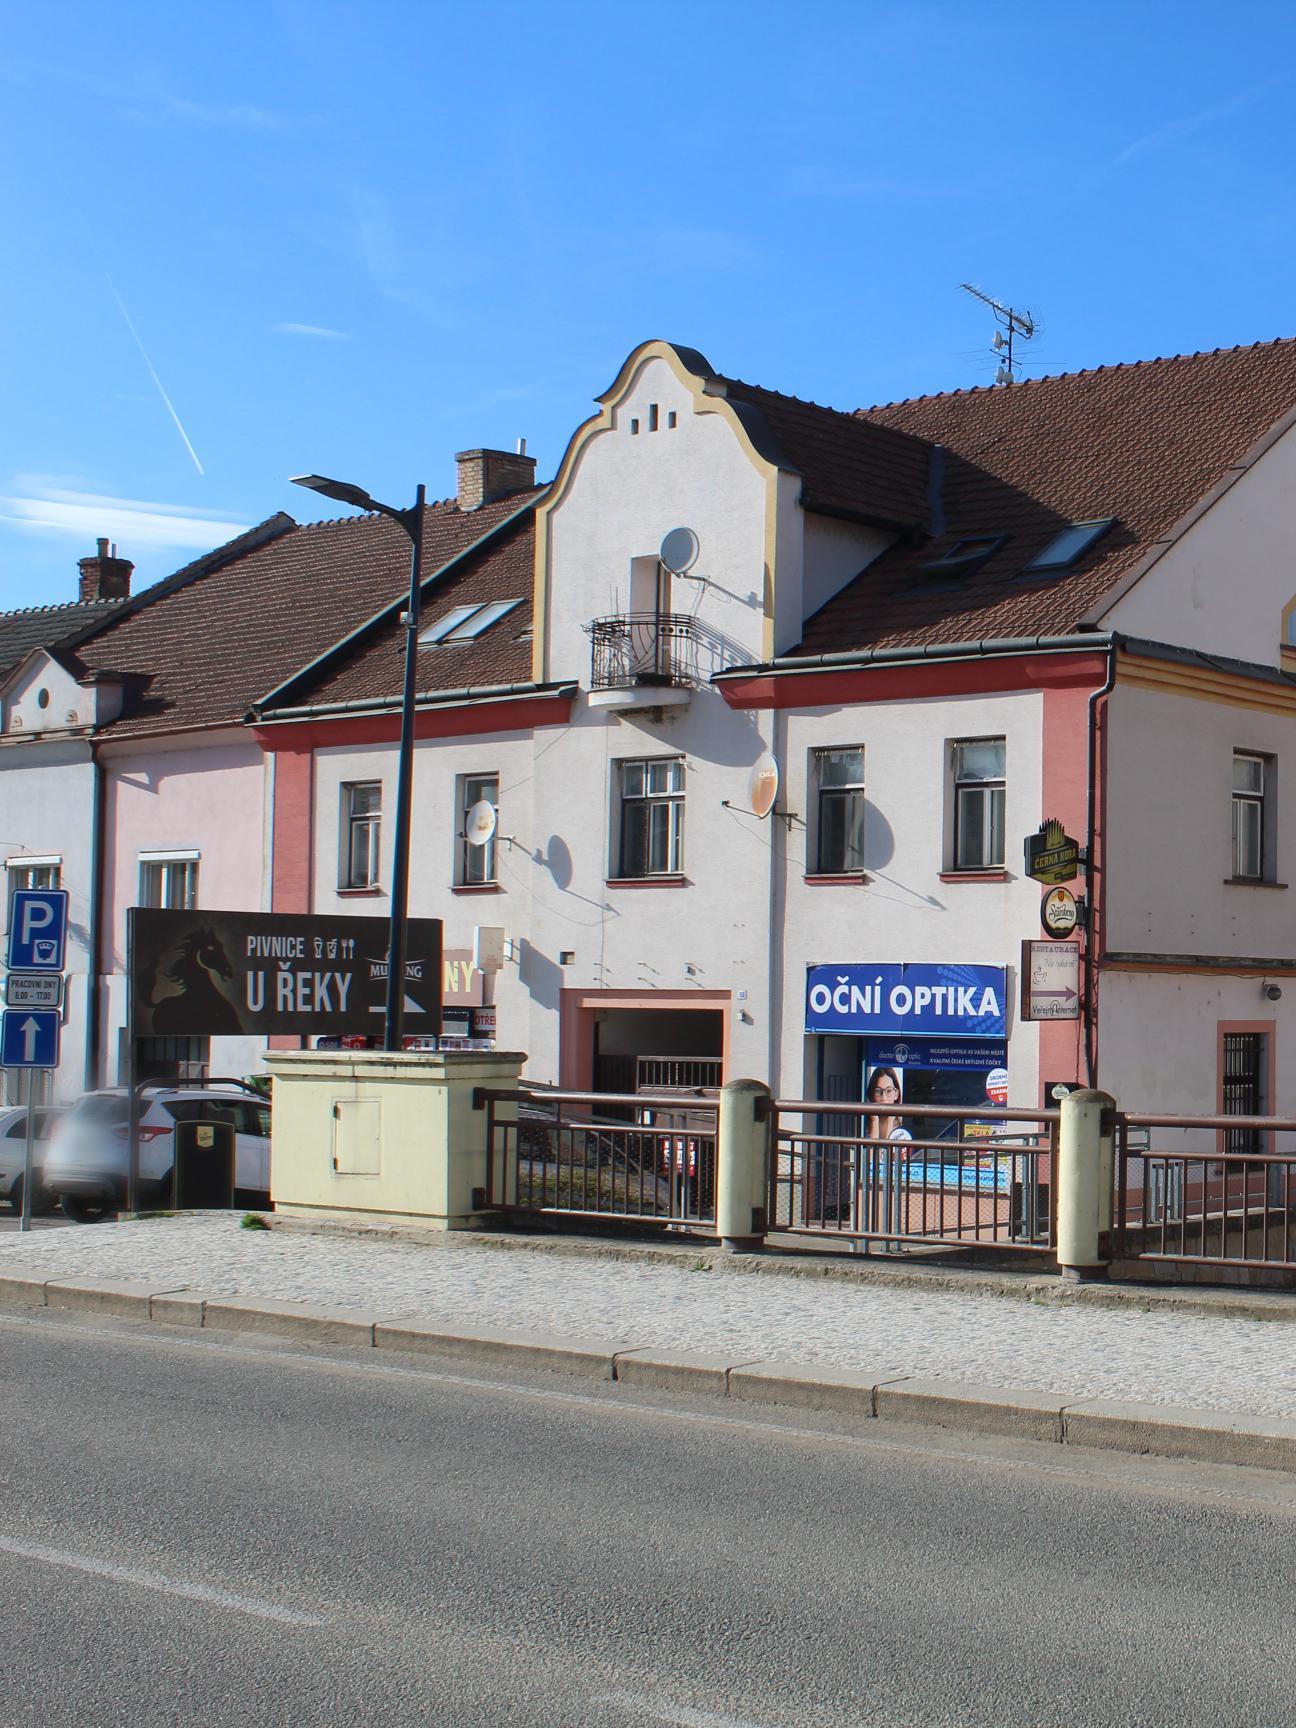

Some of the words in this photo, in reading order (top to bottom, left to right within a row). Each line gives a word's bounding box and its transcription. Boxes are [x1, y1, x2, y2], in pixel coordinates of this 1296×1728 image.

[22, 901, 54, 944] P
[247, 936, 305, 958] PIVNICE
[44, 980, 57, 989] DNY
[247, 970, 265, 1012] U
[277, 961, 352, 1012] ŘEKY
[370, 964, 422, 978] MUNG
[810, 975, 883, 1014] OČNÍ
[889, 984, 1001, 1017] OPTIKA
